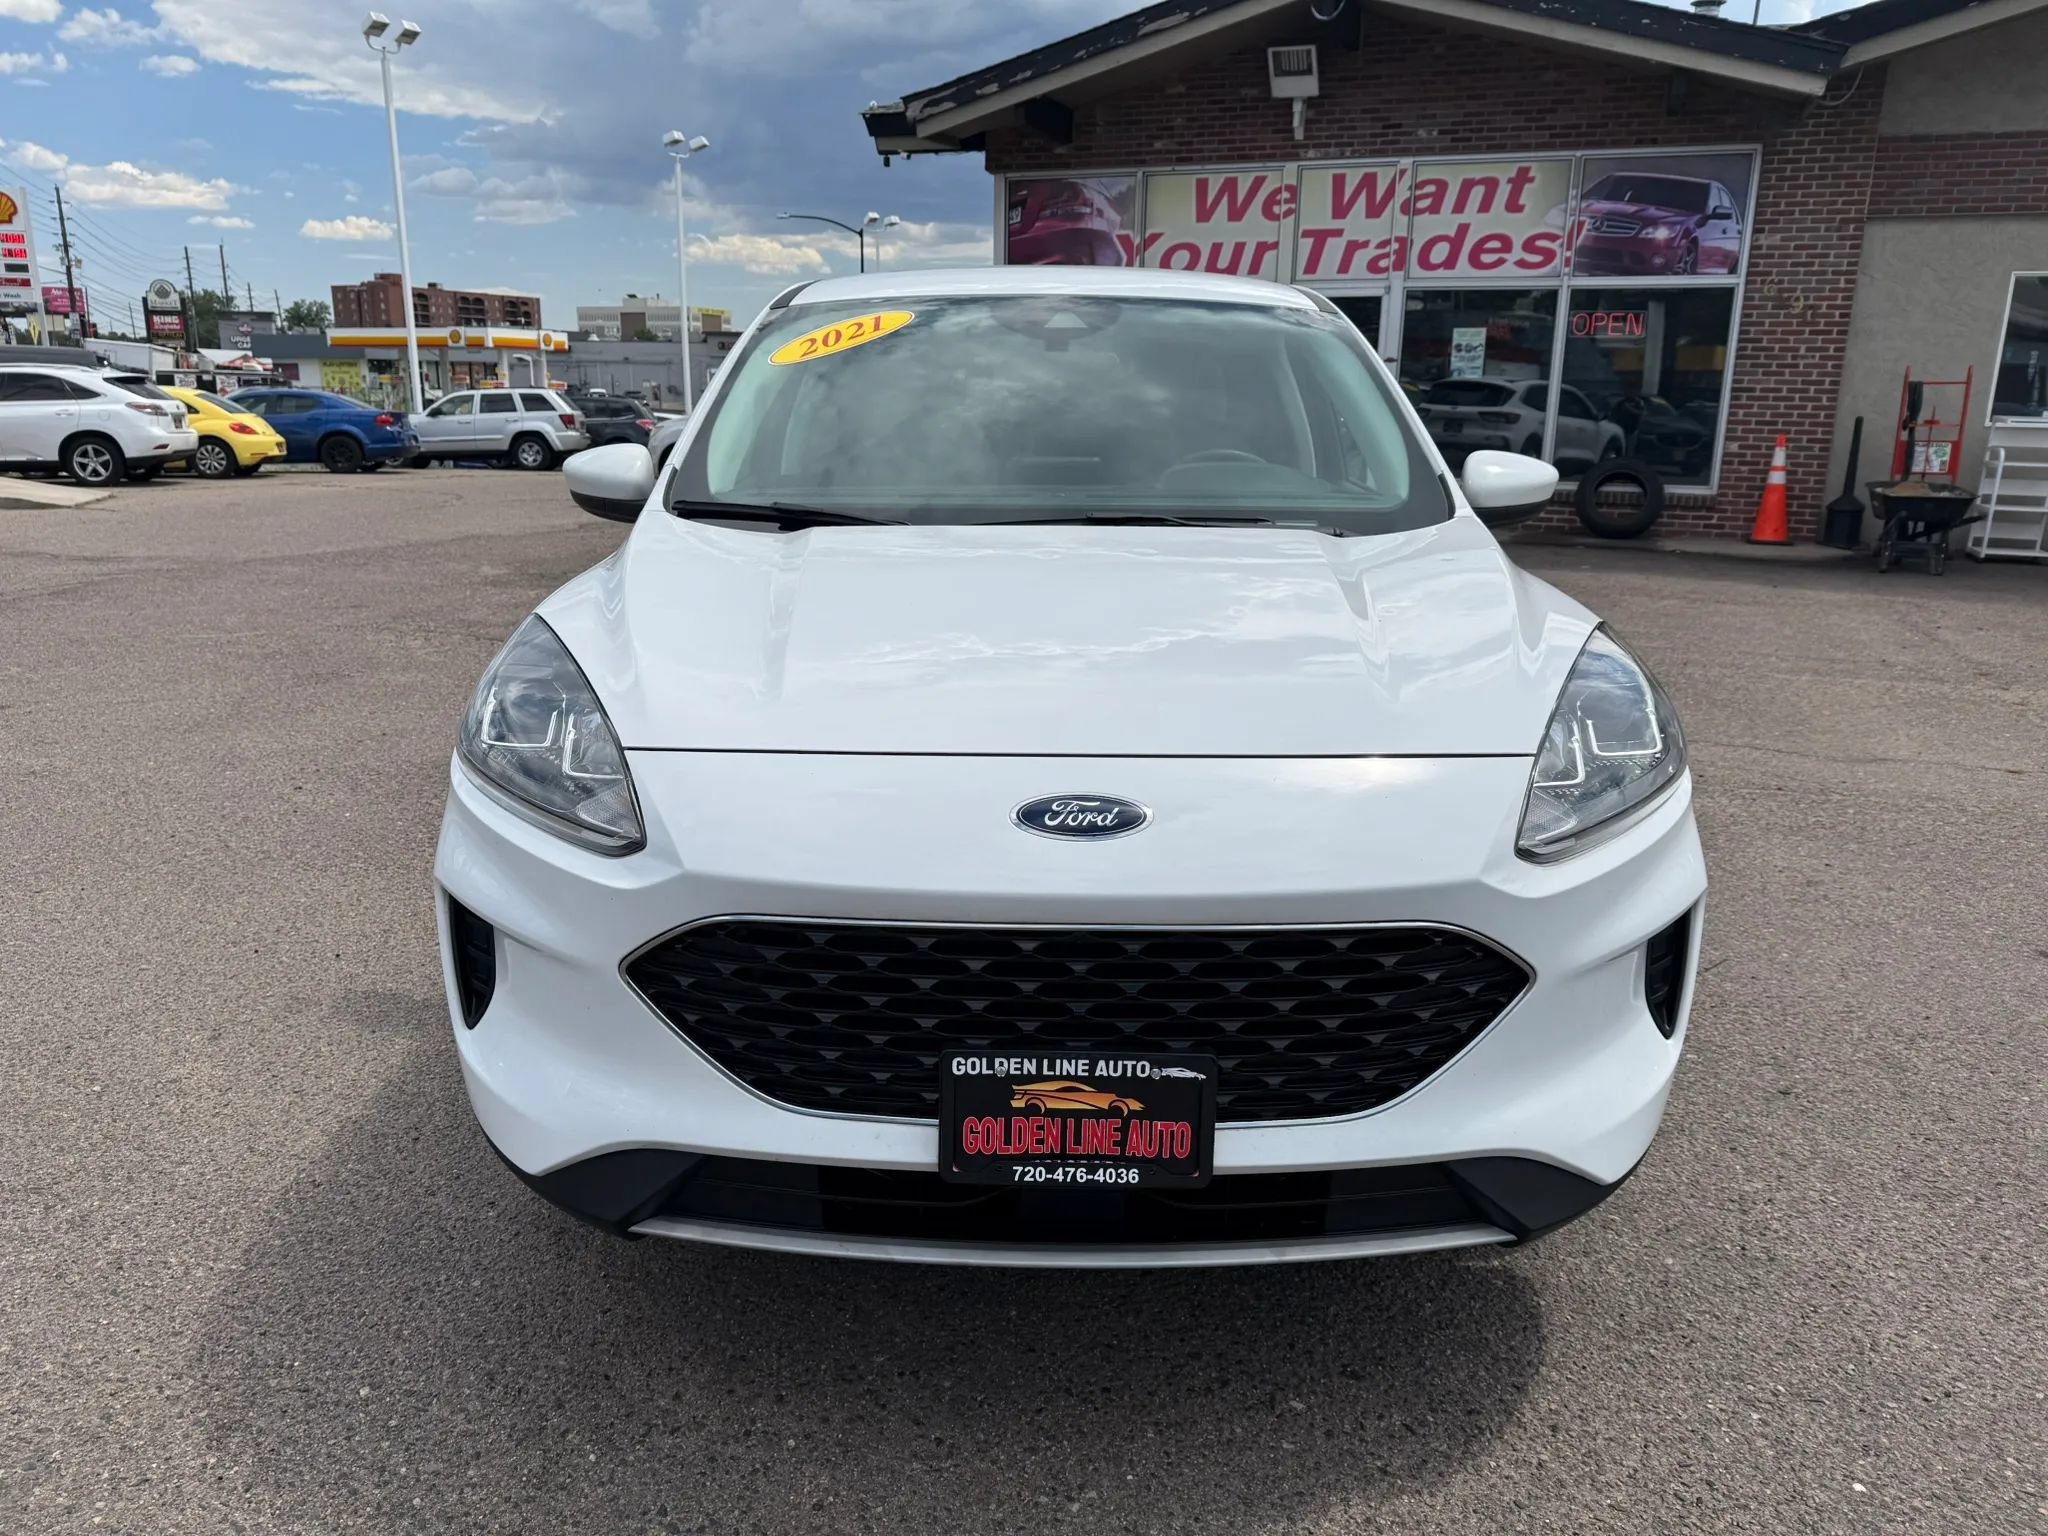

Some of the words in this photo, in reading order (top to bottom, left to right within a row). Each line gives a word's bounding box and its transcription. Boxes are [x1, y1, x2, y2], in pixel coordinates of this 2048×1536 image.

[1195, 175, 1297, 223] We
[1332, 166, 1535, 220] Want
[1115, 232, 1280, 275] Your
[1300, 222, 1585, 275] Trades!
[799, 315, 885, 358] 2021
[1572, 312, 1645, 337] OPEN
[1044, 799, 1120, 827] Ford
[952, 1057, 1037, 1077] GOLDEN
[1042, 1058, 1090, 1077] LINE
[1094, 1059, 1151, 1078] AUTO
[963, 1116, 1062, 1155] GOLDEN
[1066, 1118, 1122, 1155] LINE
[1125, 1119, 1192, 1159] AUTO
[1012, 1166, 1140, 1184] 720-476-4036
